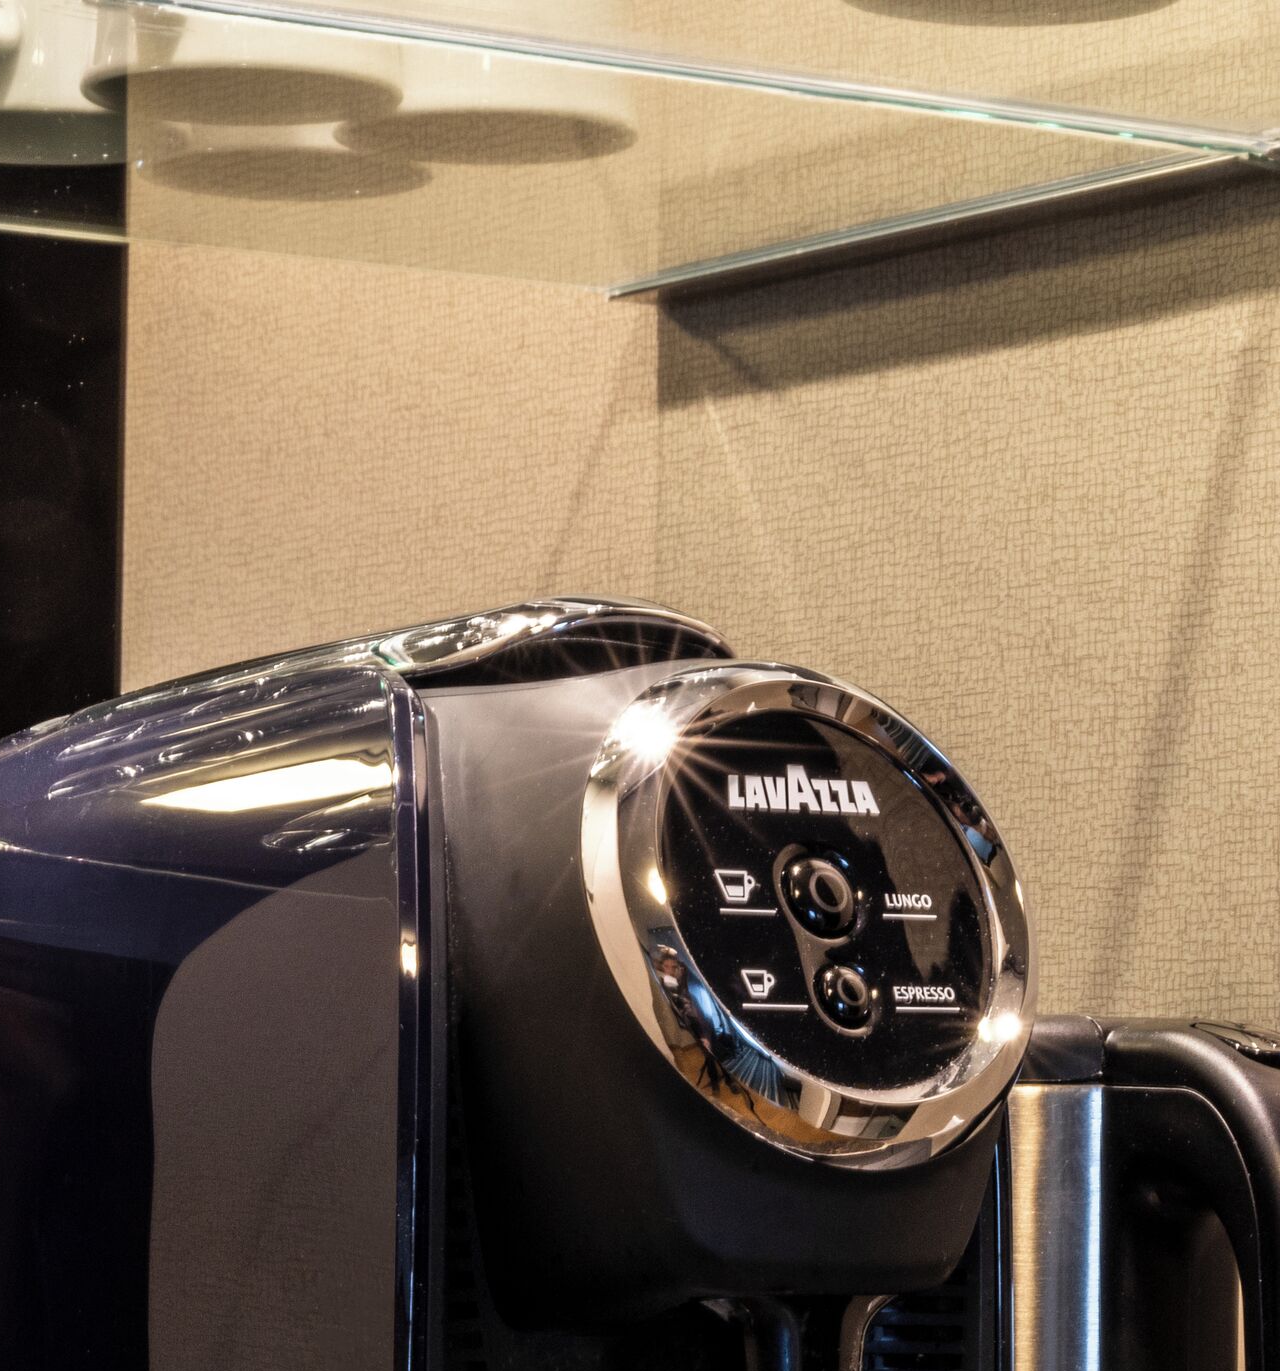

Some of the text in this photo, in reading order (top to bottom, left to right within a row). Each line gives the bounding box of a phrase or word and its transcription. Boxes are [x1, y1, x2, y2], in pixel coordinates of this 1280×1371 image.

[727, 763, 880, 816] LAVAZZA
[885, 894, 932, 910] LUNGO
[893, 984, 956, 1003] ESPRESSO
